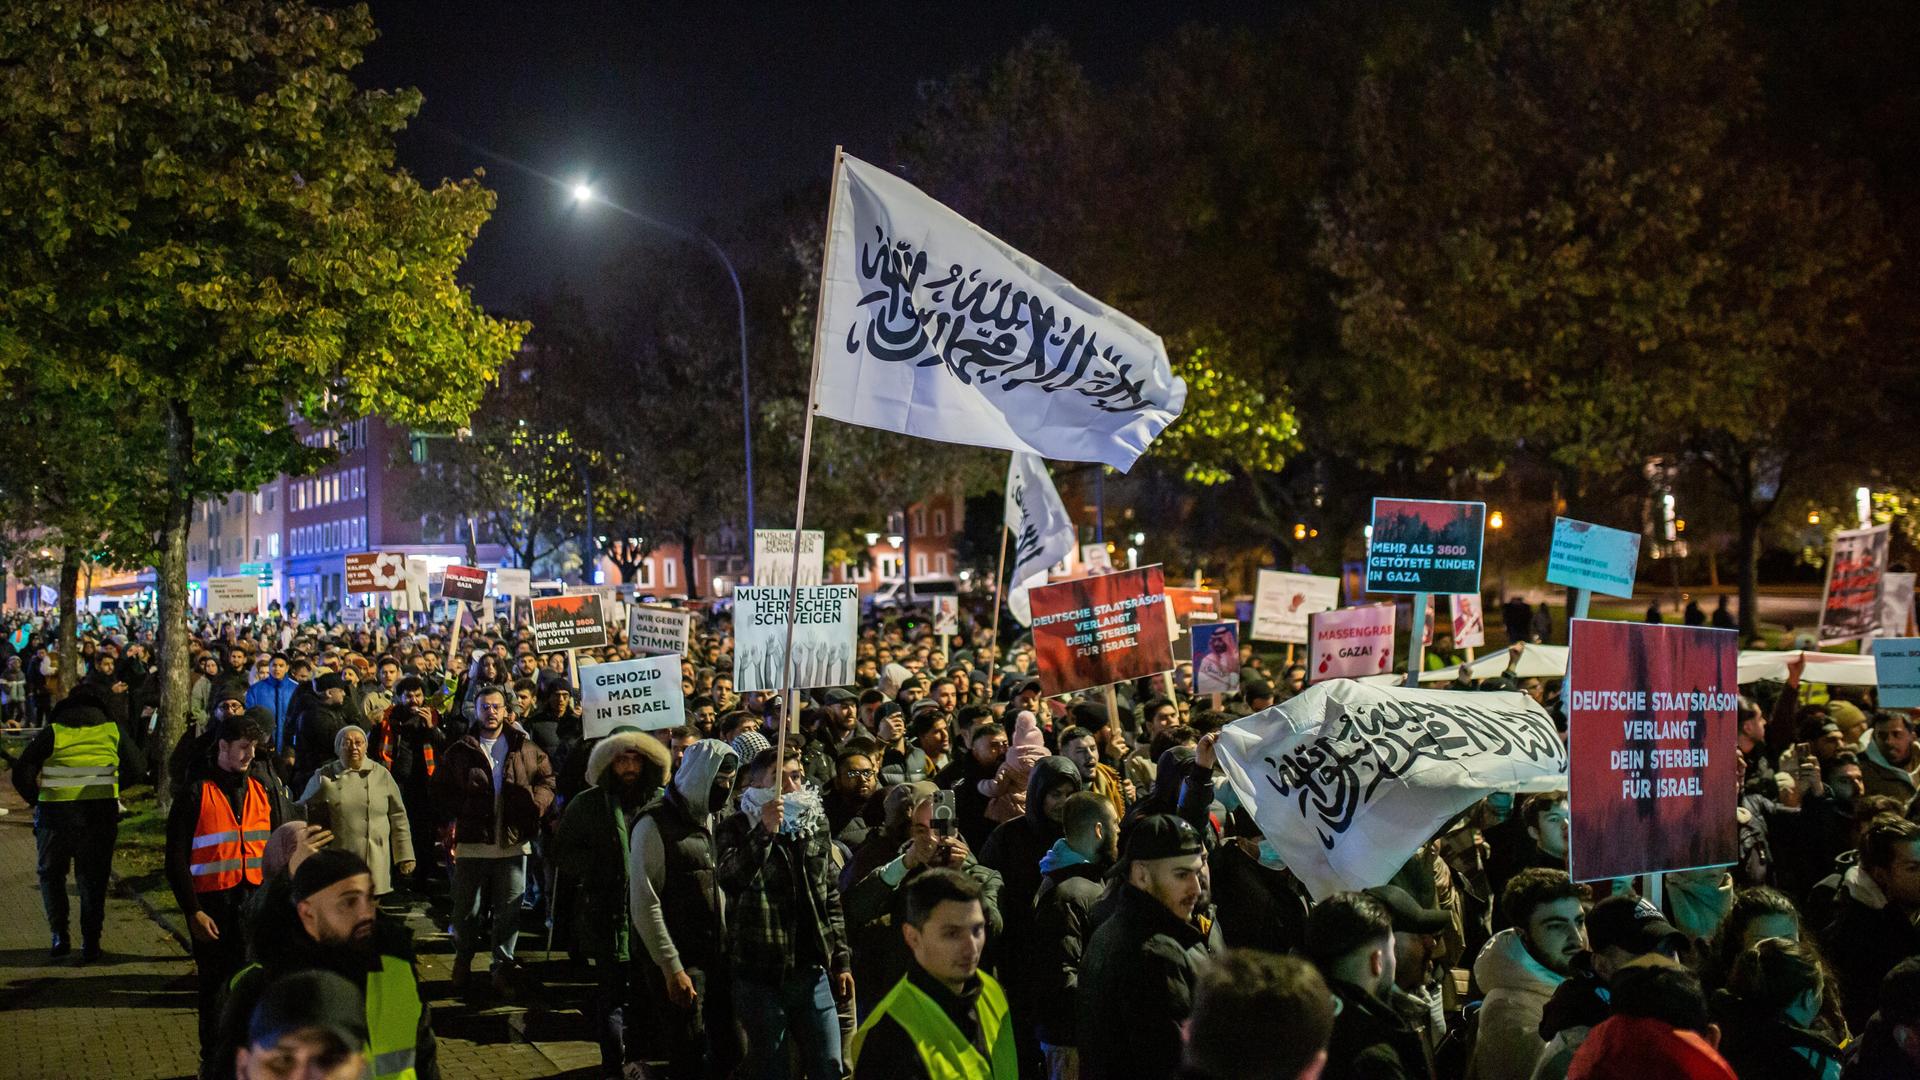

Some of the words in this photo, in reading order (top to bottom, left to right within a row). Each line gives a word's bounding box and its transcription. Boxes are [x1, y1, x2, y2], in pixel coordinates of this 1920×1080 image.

[1372, 542, 1407, 554] MEHR
[1410, 544, 1434, 555] ALS
[1371, 554, 1431, 569] GETÖTETE
[1434, 558, 1475, 570] KINDER
[1370, 570, 1382, 581] IN
[1386, 571, 1420, 582] GAZA
[457, 581, 473, 589] GAZA
[809, 587, 858, 600] LEIDEN
[1033, 608, 1091, 627] DEUTSCHE
[1094, 594, 1166, 616] STAATSRÄSON
[536, 620, 558, 630] MEHR
[559, 620, 574, 628] ALS
[637, 613, 653, 622] WIR
[655, 616, 684, 626] GEBEN
[1074, 612, 1132, 632] VERLANGT
[537, 627, 575, 638] GETÖTETE
[576, 625, 602, 634] KINDER
[636, 624, 659, 634] GAZA
[661, 628, 681, 637] EINE
[1066, 633, 1092, 647] DEIN
[1096, 623, 1141, 640] STERBEN
[538, 639, 547, 647] IN
[549, 637, 570, 646] GAZA
[632, 634, 685, 651] STIMME!
[1076, 642, 1100, 658] FÜR
[1102, 637, 1138, 653] ISRAEL
[1338, 646, 1373, 658] GAZA!
[595, 669, 662, 686] GENOZID
[608, 686, 652, 701] MADE
[1572, 690, 1646, 711] DEUTSCHE
[1651, 685, 1738, 711] STAATSRÄSON
[597, 707, 612, 719] IN
[618, 700, 670, 716] ISRAEL
[1623, 720, 1697, 740] VERLANGT
[1610, 750, 1644, 770] DEIN
[1650, 748, 1709, 769] STERBEN
[1622, 771, 1651, 799] FÜR
[1656, 777, 1703, 798] ISRAEL
